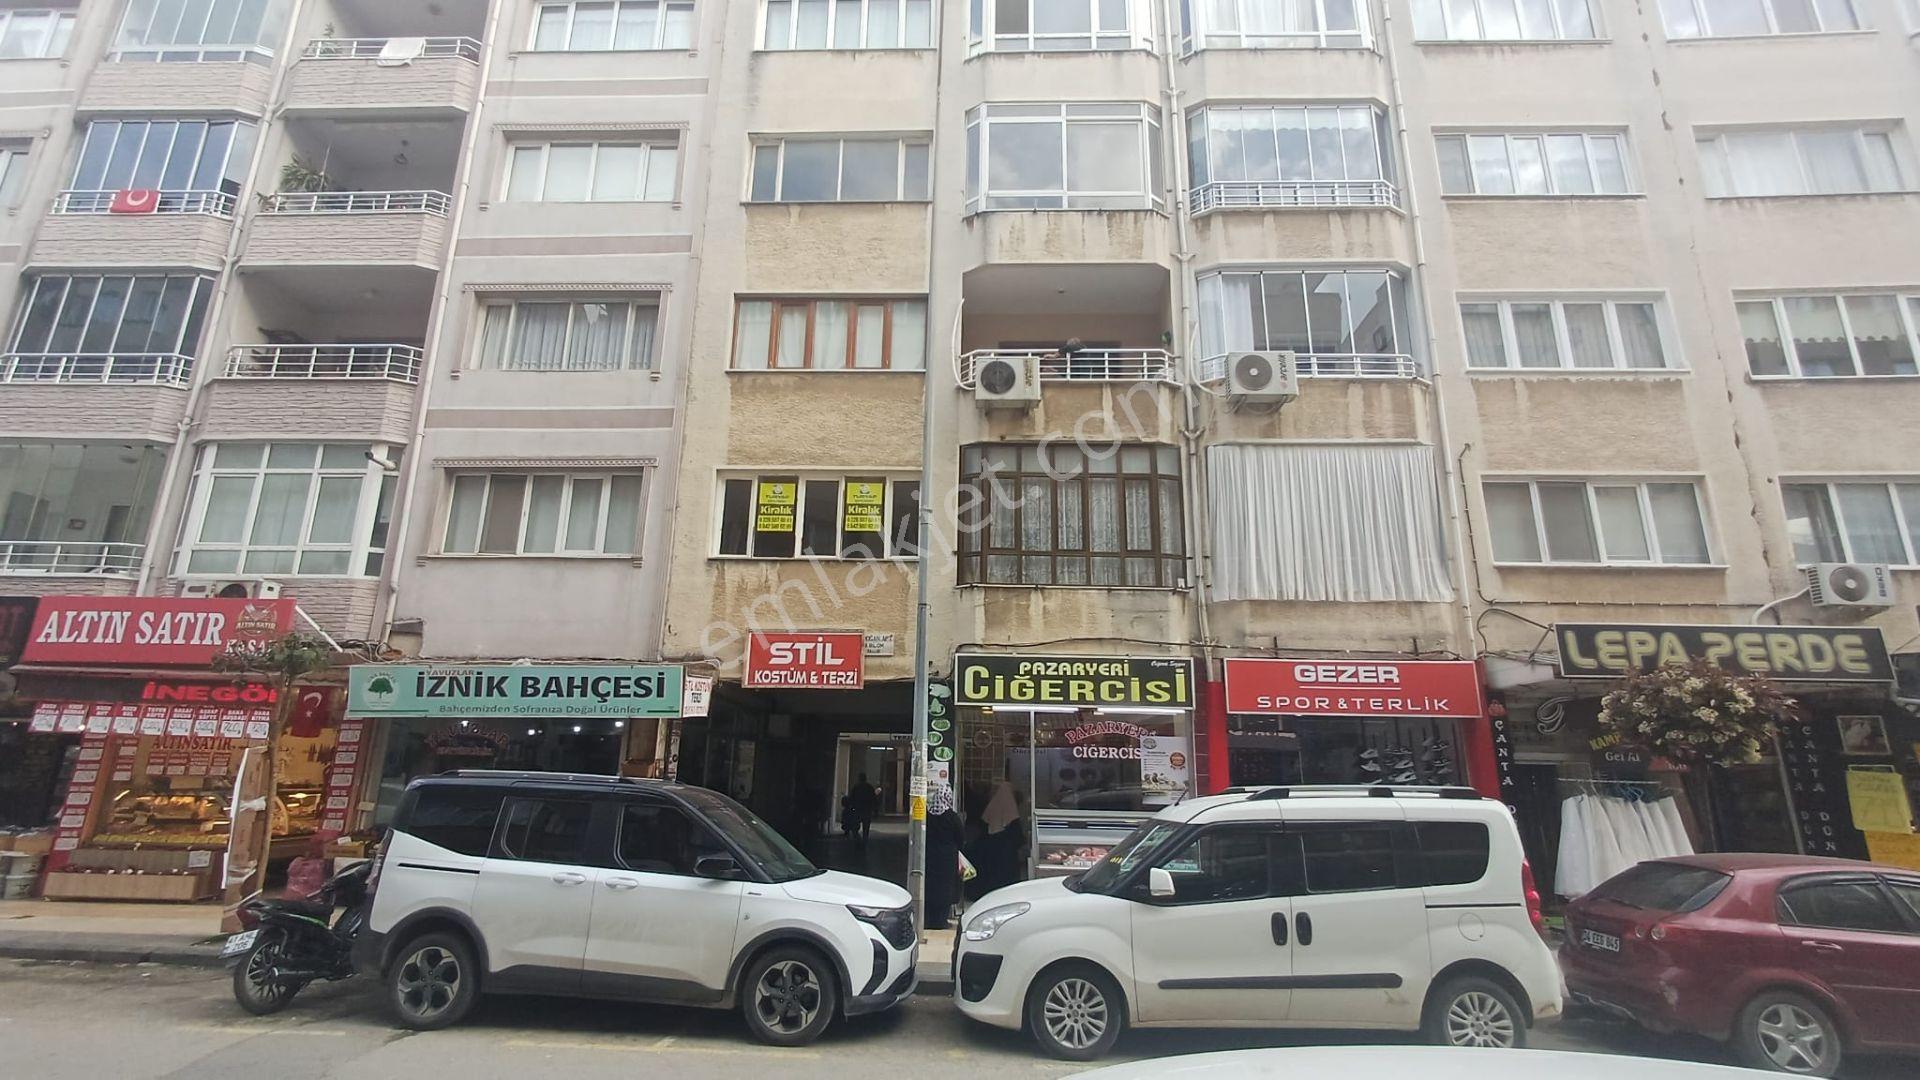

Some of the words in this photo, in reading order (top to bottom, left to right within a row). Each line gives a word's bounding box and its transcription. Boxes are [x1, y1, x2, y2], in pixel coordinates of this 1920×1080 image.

[760, 505, 792, 514] Kiralık
[848, 505, 880, 514] Kiralık
[36, 610, 132, 643] ALTIN
[135, 611, 225, 645] SATIR
[225, 639, 277, 655] KASA
[768, 636, 845, 665] STİL
[1564, 629, 1689, 669] LEPA
[754, 667, 806, 683] KOSTÜM
[810, 671, 818, 684] &
[821, 668, 858, 684] TERZİ
[1019, 660, 1130, 676] PAZARYERİ
[1294, 665, 1400, 683] GEZER
[416, 671, 509, 698] İZNİK
[520, 671, 666, 703] BAHÇESİ
[964, 665, 1186, 703] CİĞERCİSİ
[439, 705, 510, 714] Bahçemizden
[513, 705, 563, 714] Sofranıza
[566, 704, 597, 714] Doğal
[600, 704, 641, 714] Ürünler
[1257, 696, 1330, 709] SPOR
[1348, 696, 1449, 711] TERLİK
[1065, 720, 1157, 744] PAZARYER
[1073, 743, 1142, 759] CİĞERCİS
[1494, 720, 1514, 785] ÇANTA
